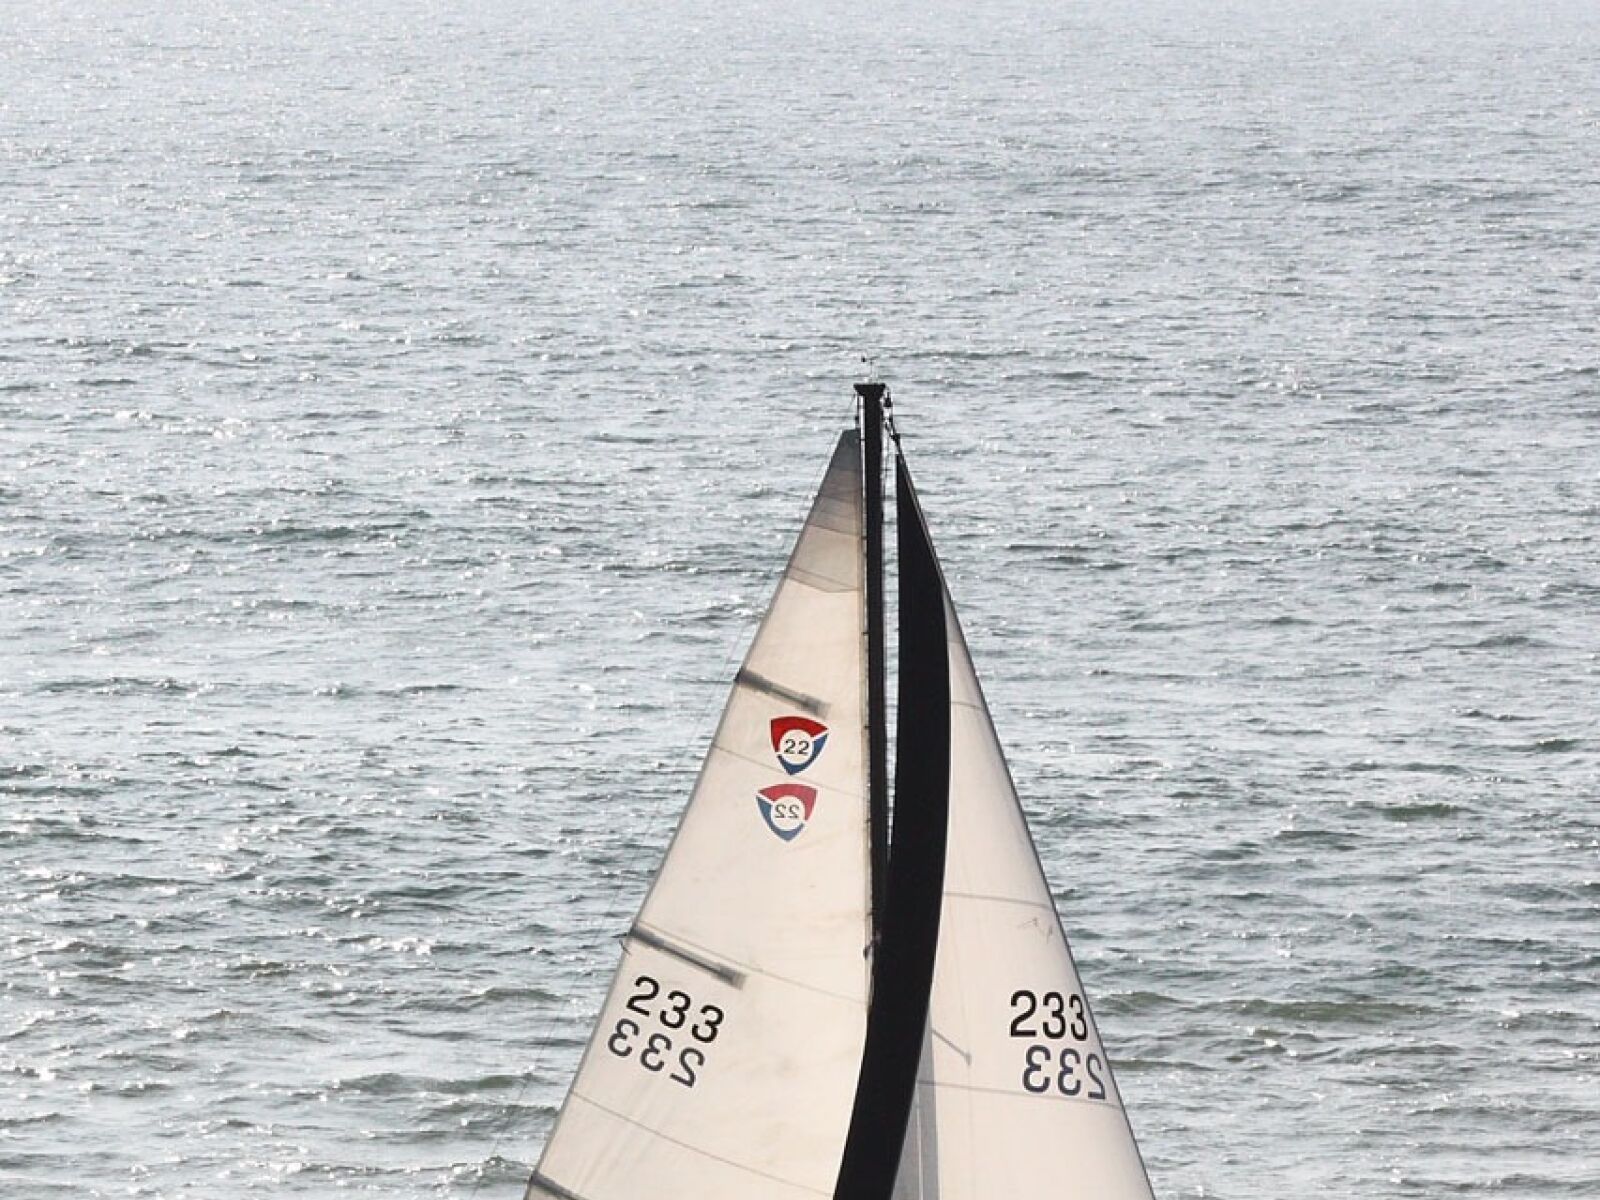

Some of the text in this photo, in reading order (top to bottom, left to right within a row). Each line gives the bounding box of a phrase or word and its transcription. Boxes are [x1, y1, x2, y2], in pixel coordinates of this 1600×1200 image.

[783, 738, 810, 755] 22
[626, 975, 725, 1044] 233
[1009, 989, 1088, 1041] 233
